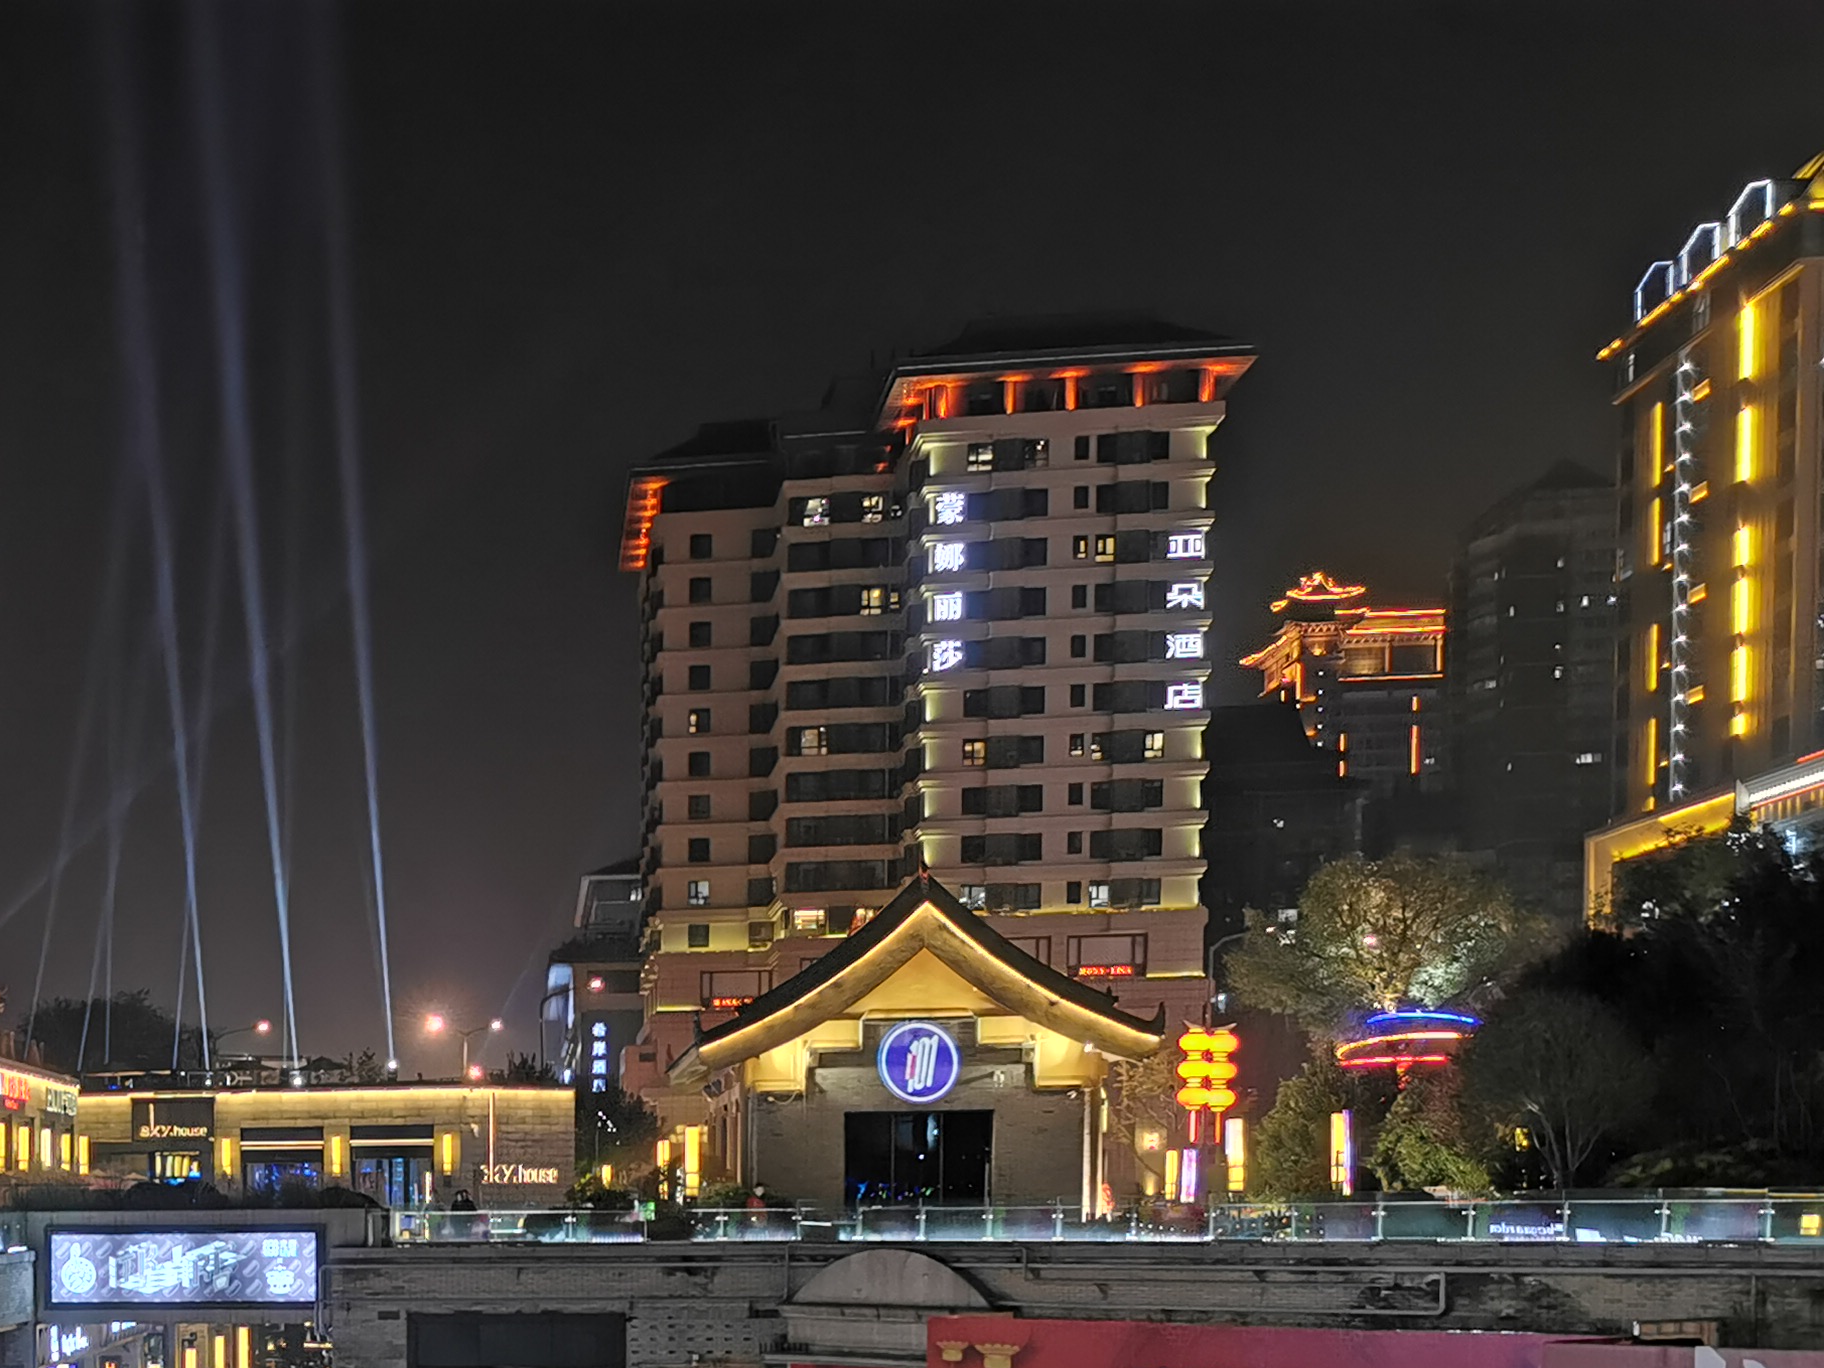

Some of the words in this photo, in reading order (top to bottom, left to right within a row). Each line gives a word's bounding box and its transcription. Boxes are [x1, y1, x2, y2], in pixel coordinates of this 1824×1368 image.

[931, 493, 966, 671] 蒙娜丽莎
[1165, 532, 1205, 710] 亚朵酒店
